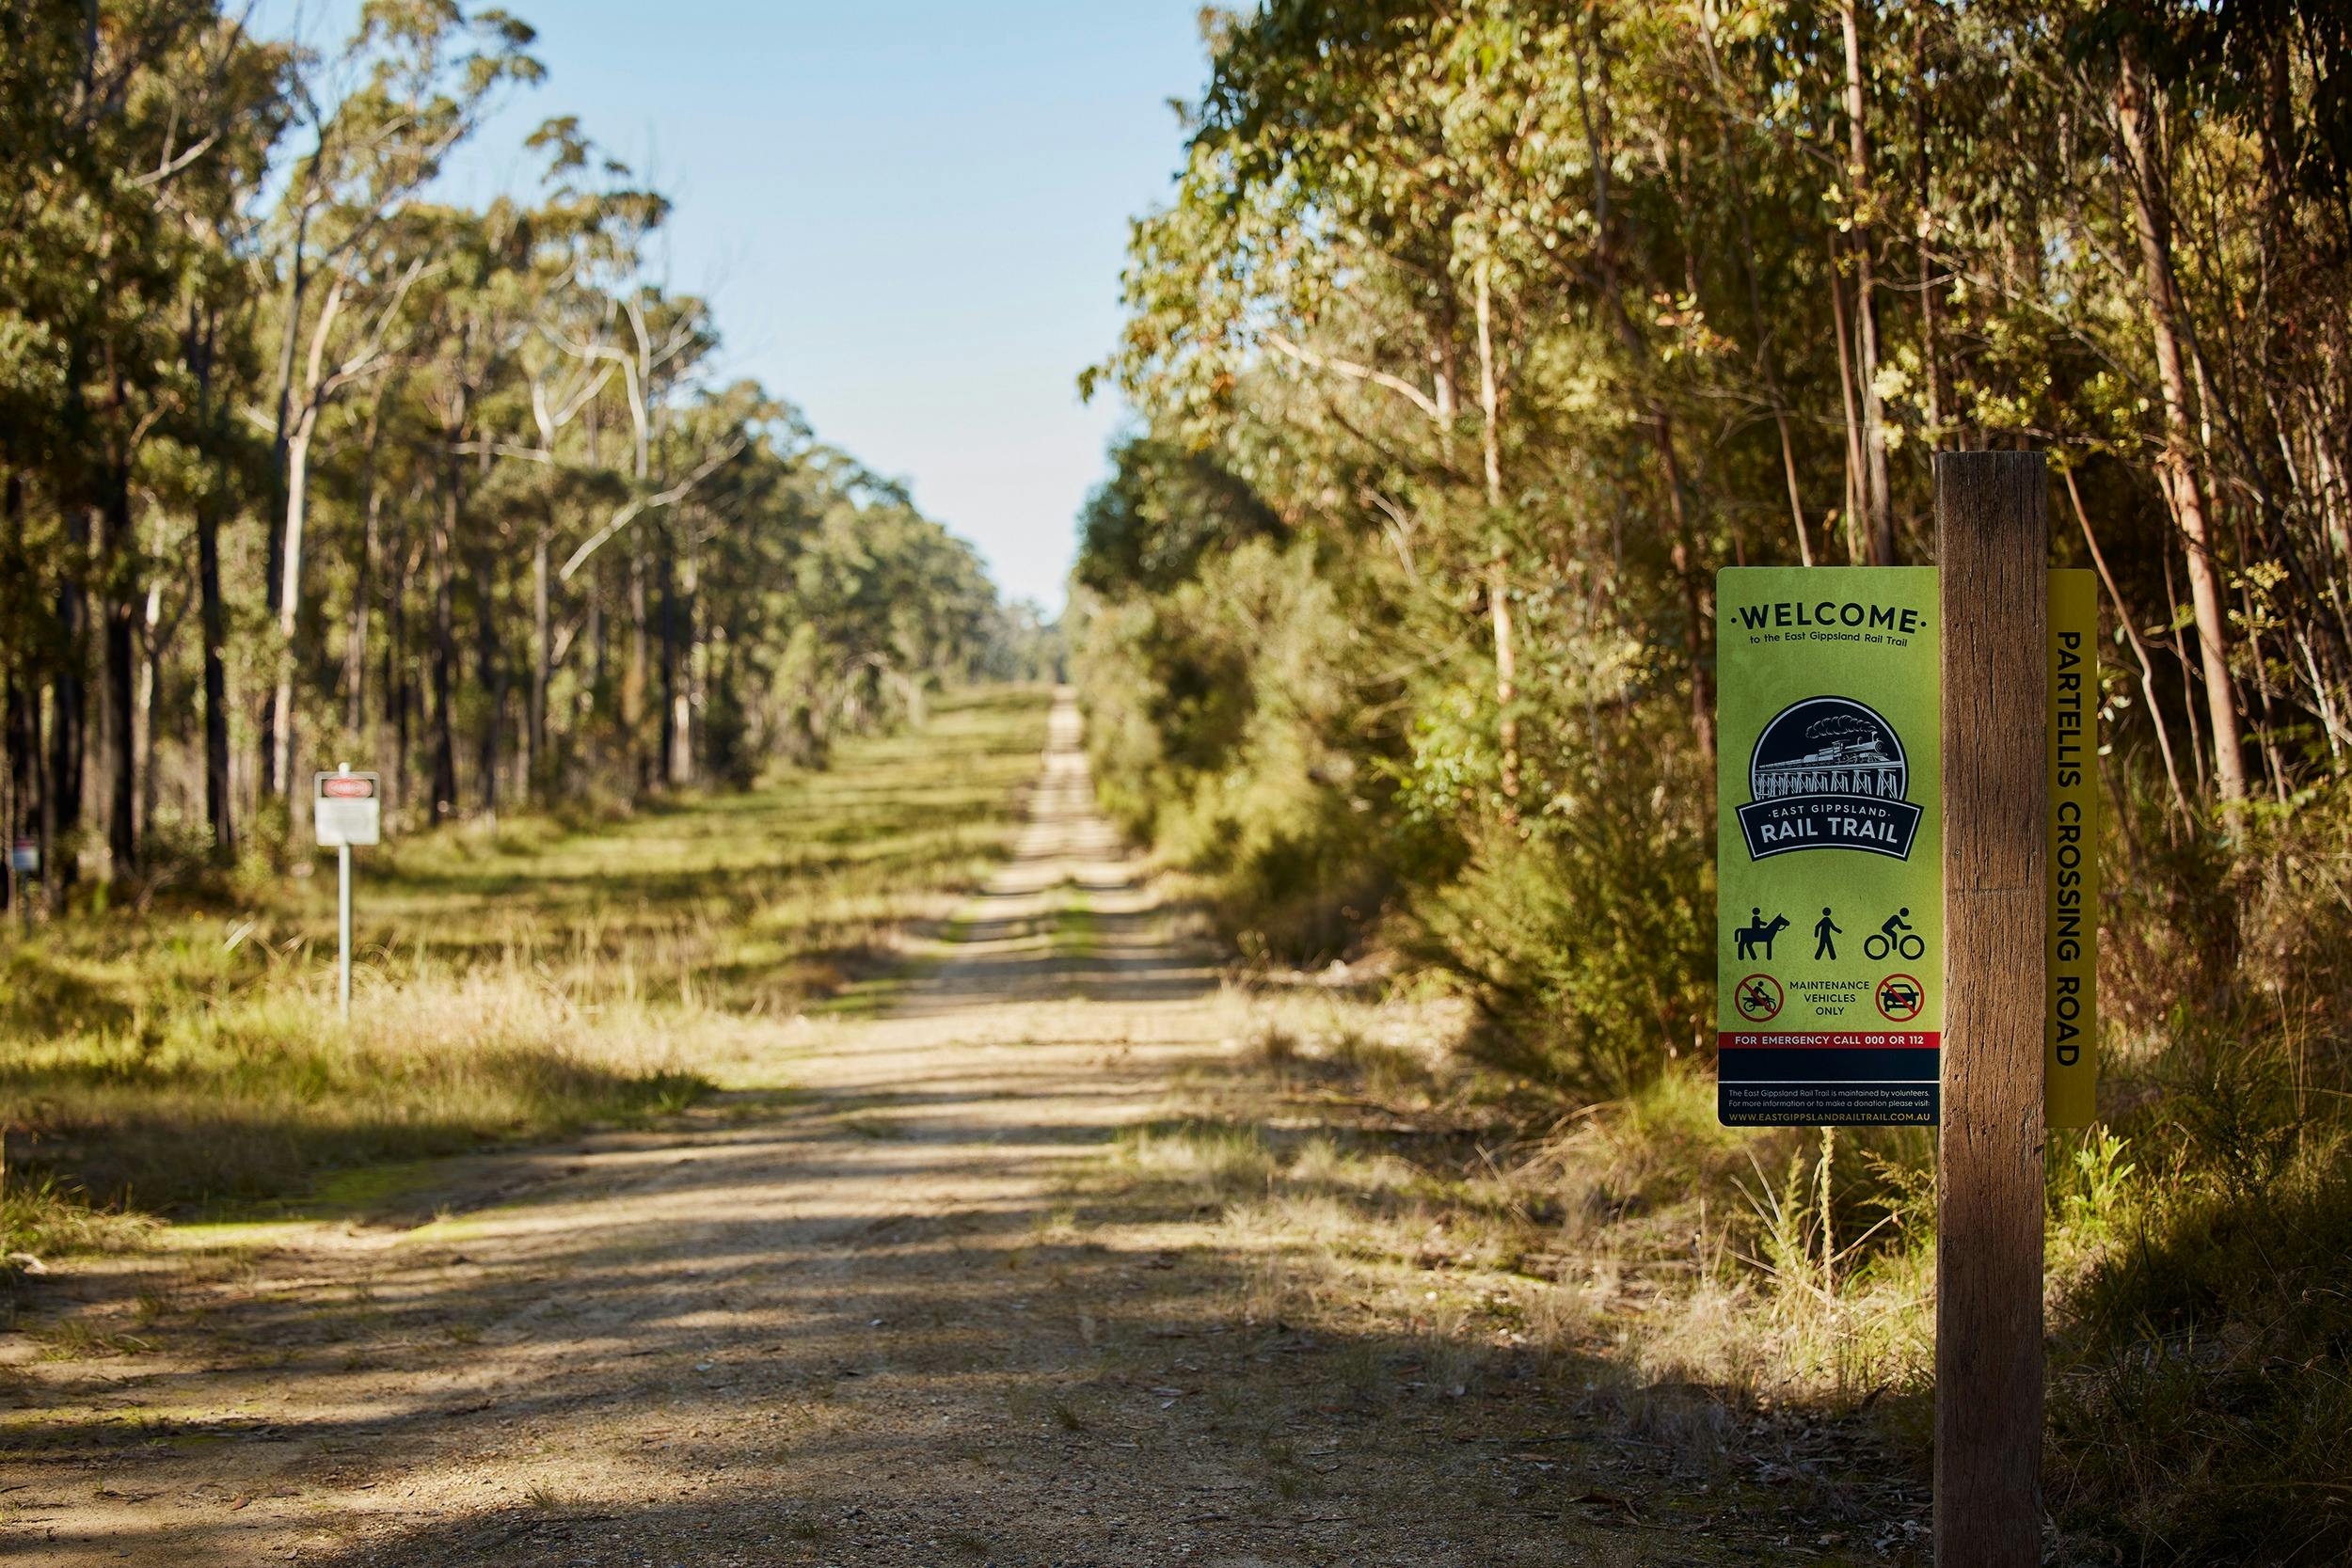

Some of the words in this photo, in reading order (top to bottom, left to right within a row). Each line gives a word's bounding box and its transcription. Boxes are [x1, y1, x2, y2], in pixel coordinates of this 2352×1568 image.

[1739, 602, 1918, 635] WELCOME
[1749, 635, 1761, 644] to
[1764, 633, 1780, 642] the
[1784, 631, 1806, 641] East
[1809, 631, 1861, 642] Gippsland
[1864, 633, 1883, 643] Rail
[1886, 635, 1908, 647] Trail
[2058, 632, 2081, 788] PARTELLIS
[1772, 805, 1804, 817] EAST
[1811, 804, 1887, 817] GIPPSLAND
[1760, 818, 1819, 843] RAIL
[1827, 817, 1899, 844] TRAIL
[2057, 801, 2081, 962] CROSSING
[1789, 981, 1869, 990] MAINTENANCE
[1804, 994, 1856, 1003] VEHICLES
[1815, 1006, 1845, 1016] ONLY
[2056, 976, 2081, 1067] ROAD
[1735, 1036, 1757, 1045] FOR
[1761, 1036, 1830, 1045] EMERGENCY
[1833, 1036, 1861, 1045] CALL
[1865, 1036, 1885, 1045] 000
[1889, 1036, 1905, 1045] OR
[1909, 1036, 1924, 1045] 112
[1760, 1089, 1799, 1098] Gippsland
[1880, 1089, 1889, 1099] by
[1888, 1100, 1914, 1108] please
[1728, 1113, 1931, 1121] WWW.EASTGIPPSLANDRAILTRAIL.COM.AU
